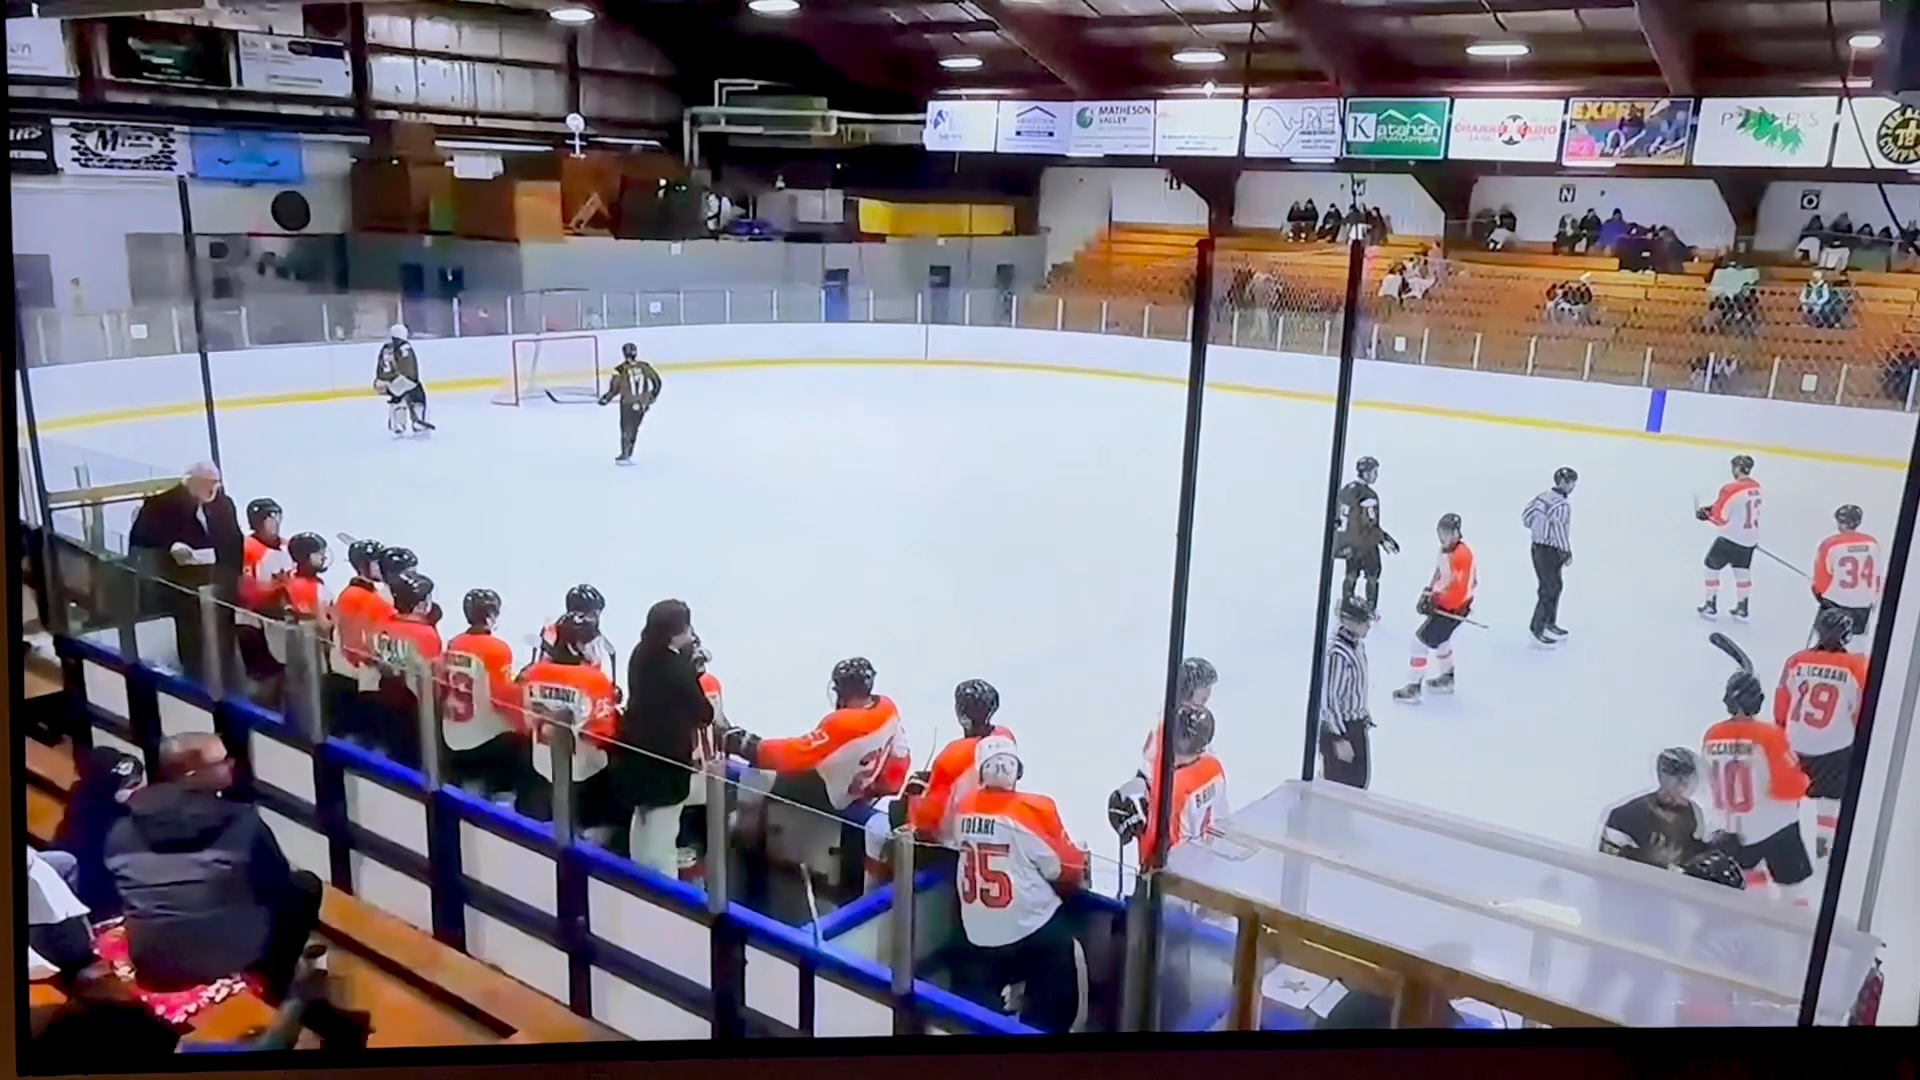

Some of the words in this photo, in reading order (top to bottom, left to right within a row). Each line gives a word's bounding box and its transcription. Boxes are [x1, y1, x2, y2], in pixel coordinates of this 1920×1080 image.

[1099, 105, 1151, 115] MATHESON
[1561, 187, 1574, 203] N
[1803, 194, 1818, 209] O
[1838, 555, 1874, 589] 34
[1790, 680, 1840, 730] 19
[1706, 758, 1754, 813] 10
